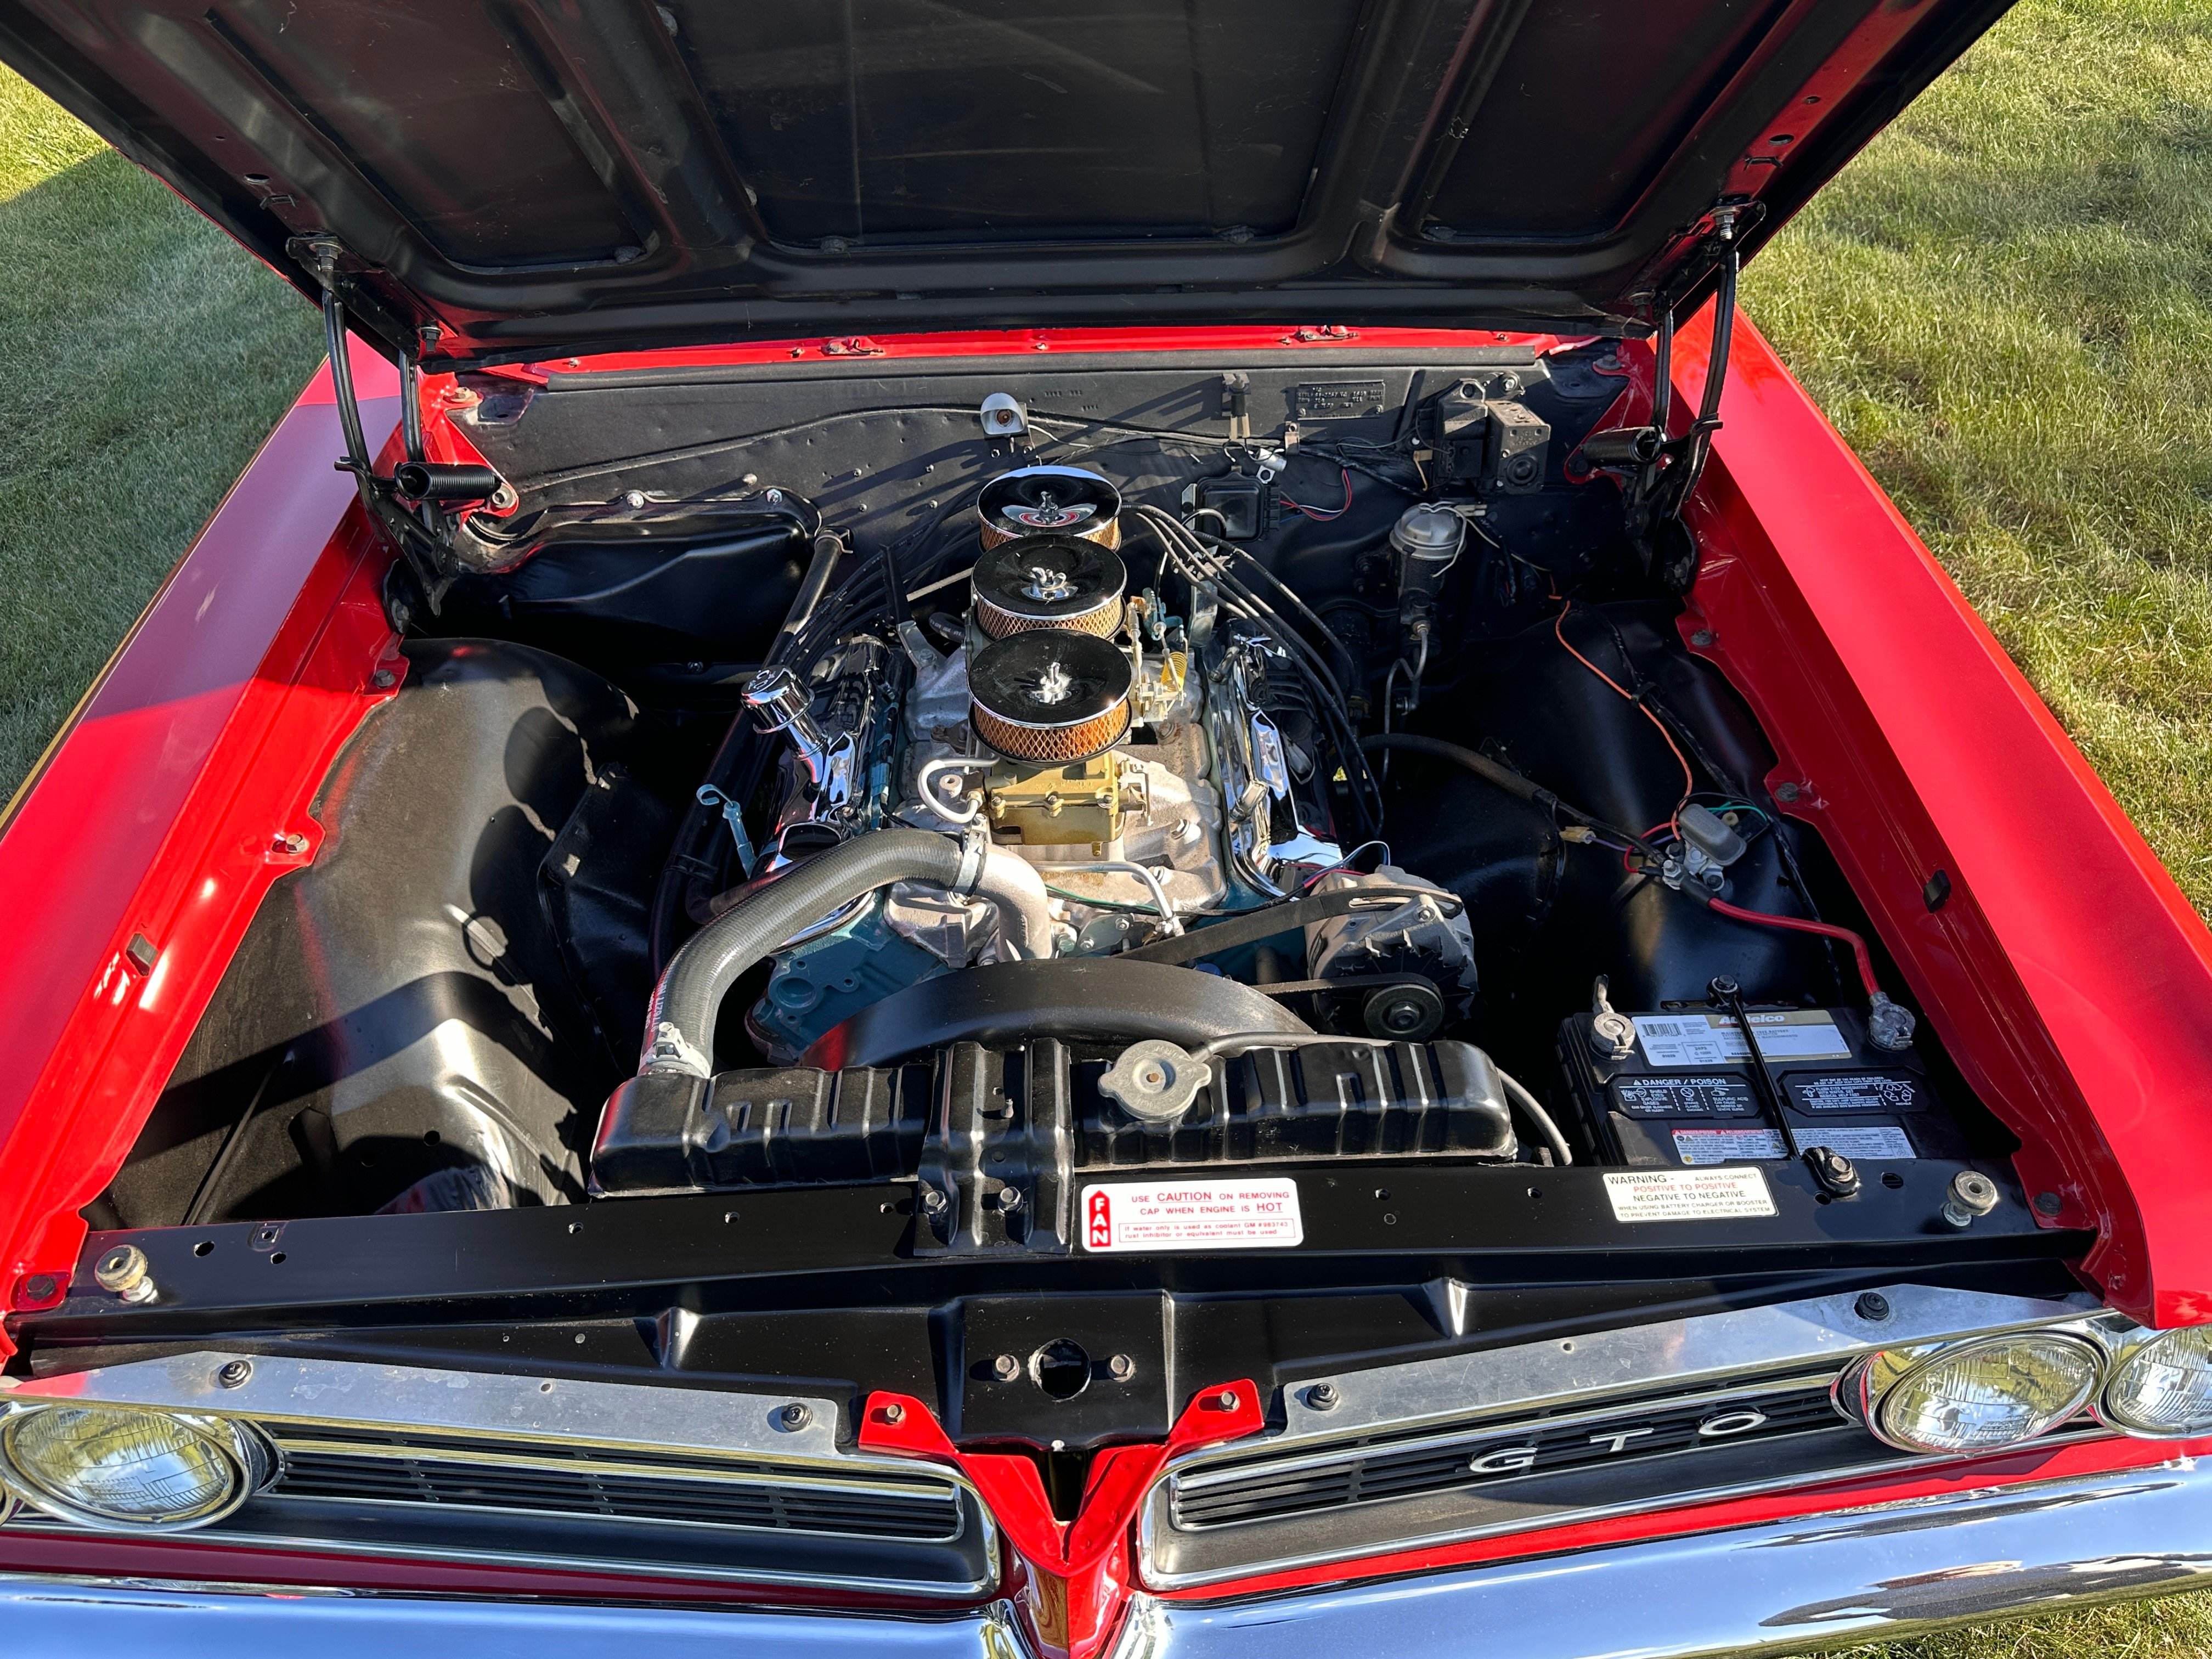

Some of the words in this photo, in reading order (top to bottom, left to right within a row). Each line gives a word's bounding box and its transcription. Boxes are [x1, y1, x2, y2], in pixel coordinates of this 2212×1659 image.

[1607, 1175, 1667, 1184] WARNING
[1695, 1182, 1738, 1190] POSITIVE
[1157, 1192, 1212, 1201] CAUTION
[1699, 1190, 1746, 1199] NEGATIVE
[1257, 1203, 1283, 1211] HOT
[1092, 1197, 1108, 1244] FAN
[1469, 1410, 1767, 1473] GTO
